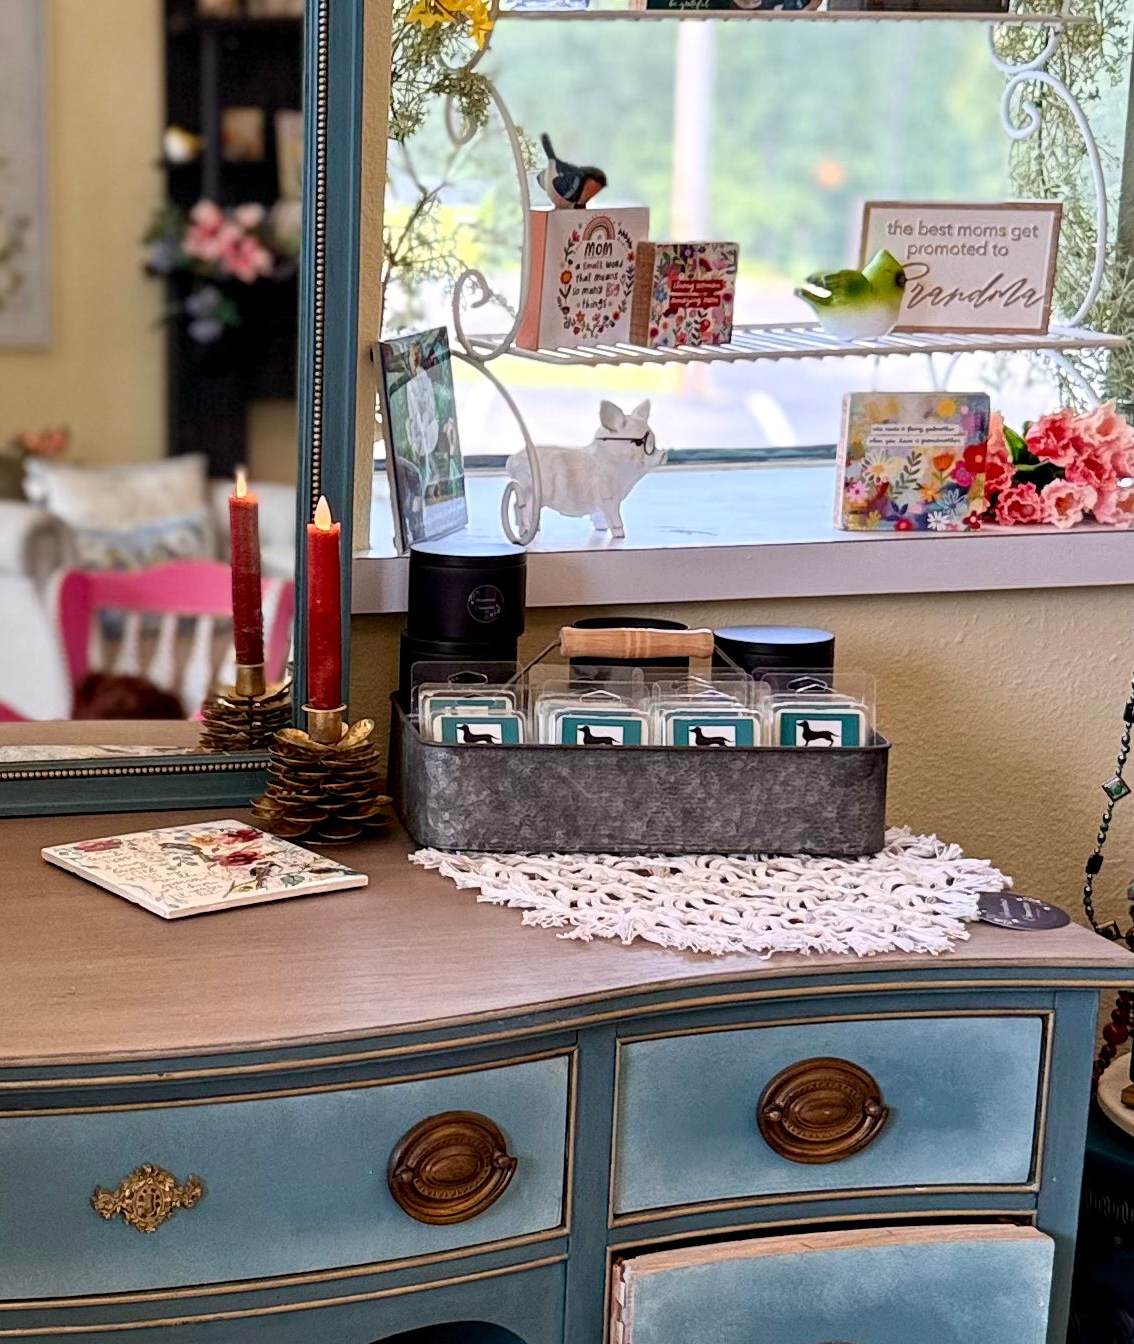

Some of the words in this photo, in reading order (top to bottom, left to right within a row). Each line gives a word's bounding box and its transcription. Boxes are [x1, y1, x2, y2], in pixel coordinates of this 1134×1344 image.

[887, 220, 913, 236] the
[918, 220, 954, 237] best
[958, 225, 1007, 238] moms
[1011, 224, 1039, 241] get
[907, 241, 987, 259] promoted
[992, 243, 1008, 256] to
